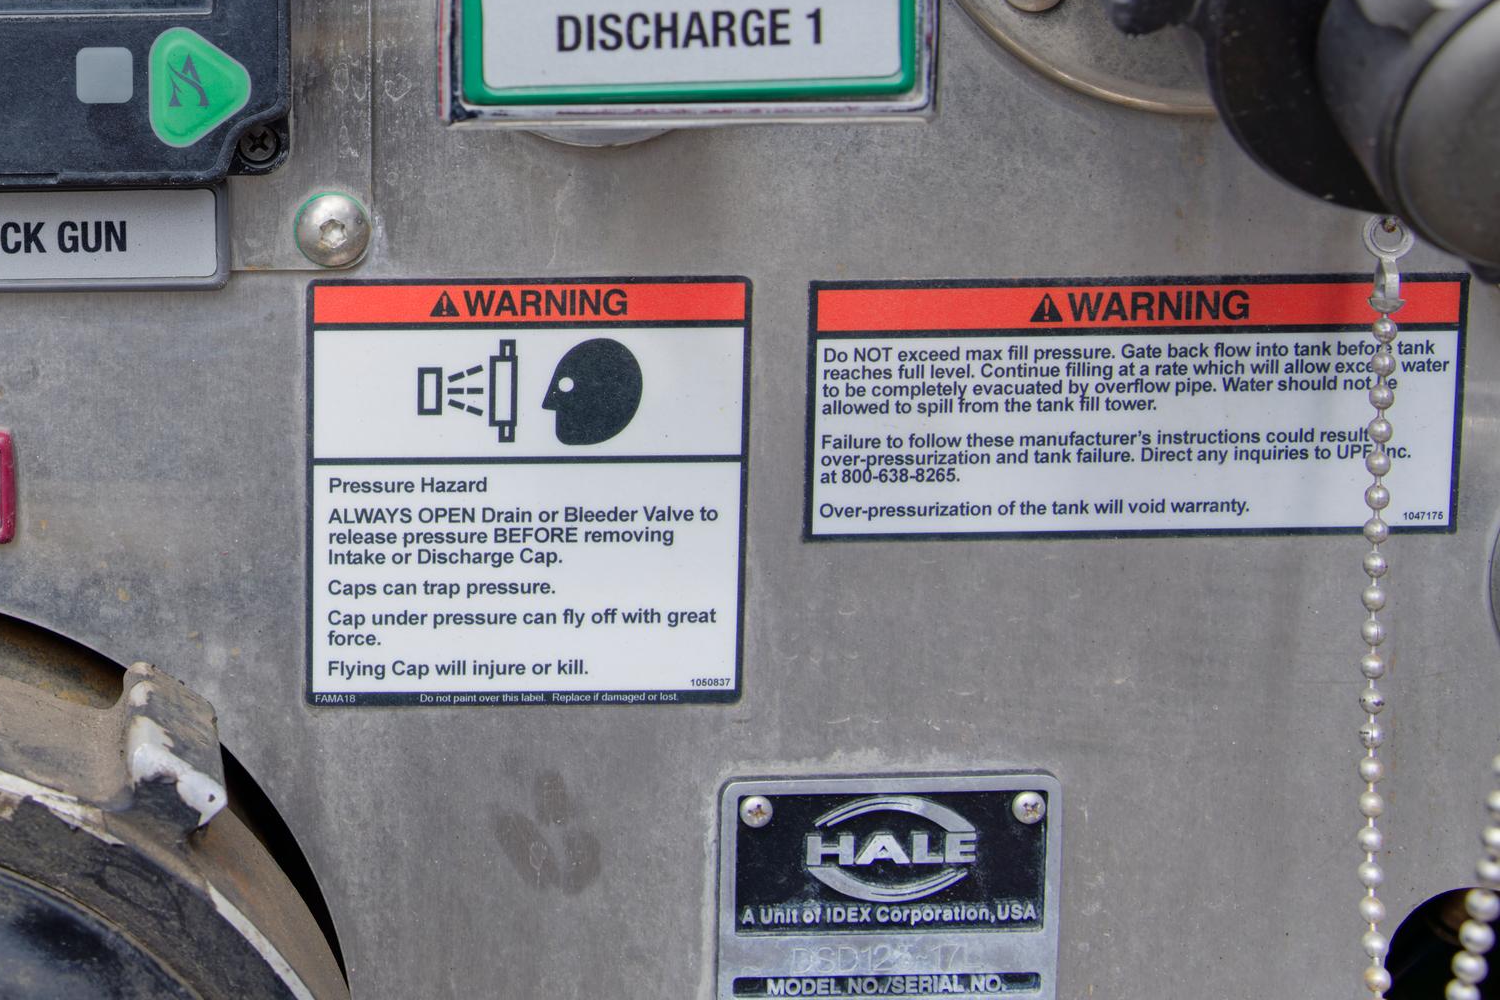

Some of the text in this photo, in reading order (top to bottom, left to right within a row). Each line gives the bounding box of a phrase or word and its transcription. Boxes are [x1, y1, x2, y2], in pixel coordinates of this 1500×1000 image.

[557, 8, 822, 52] DISCHARGE 1
[57, 220, 127, 254] GUN
[464, 289, 628, 317] WARNING
[1068, 289, 1250, 322] WARNING
[822, 396, 1156, 417] allowed to spill from the tank fill tower.
[329, 477, 487, 493] Pressure Hazard
[820, 467, 960, 484] at 800-638-8265.
[328, 505, 718, 524] ALWAYS OPEN Drain or Bleeder Valve to
[819, 498, 1249, 521] Over-pressurization of the tank will void warranty.
[328, 659, 588, 680] Flying Cap will injure or kill.
[315, 694, 356, 703] FAMA18
[420, 694, 433, 703] Do
[435, 694, 451, 703] not
[453, 693, 476, 704] paint
[502, 693, 518, 702] this
[521, 693, 545, 702] label.
[552, 693, 590, 704] Replace
[593, 692, 599, 701] if
[601, 692, 645, 703] damaged
[806, 831, 977, 866] HALE
[742, 908, 756, 924] A
[760, 907, 798, 924] Unit
[802, 906, 822, 923] of
[826, 906, 871, 922] IDEX
[766, 976, 841, 997] MODEL
[969, 974, 1008, 994] NO.
